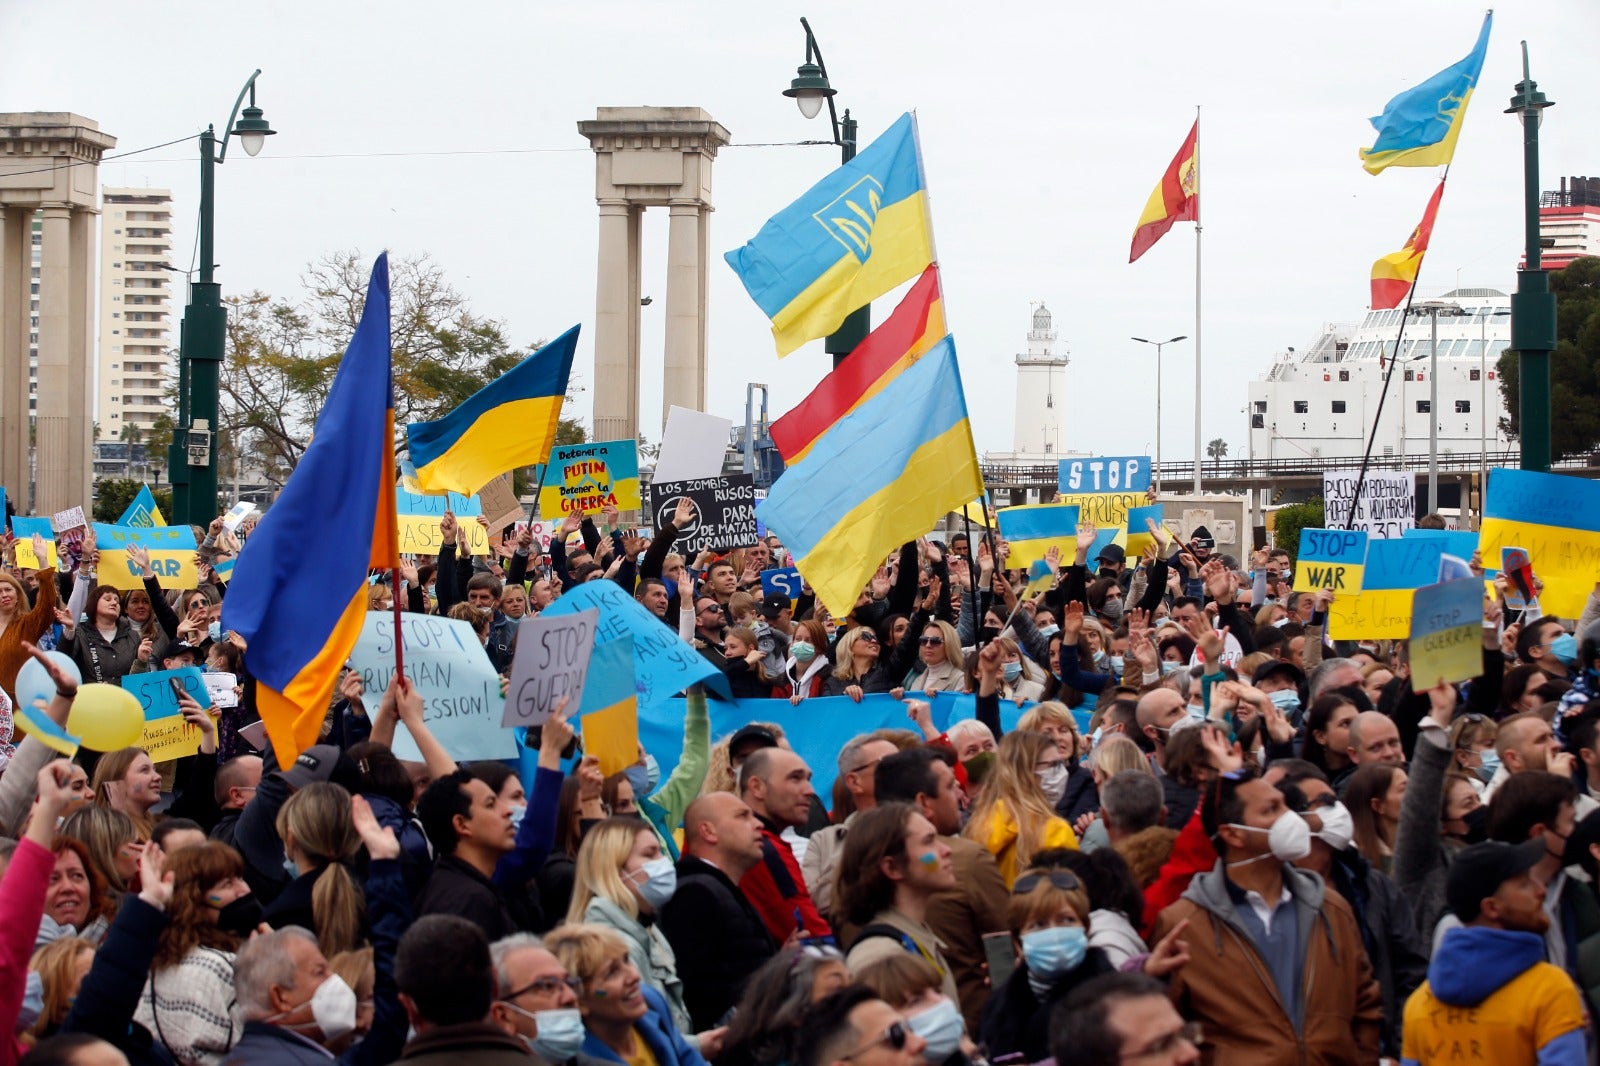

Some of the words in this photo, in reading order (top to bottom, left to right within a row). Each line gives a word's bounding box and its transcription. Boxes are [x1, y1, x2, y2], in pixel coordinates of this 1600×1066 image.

[558, 447, 597, 460] Detener
[600, 447, 608, 455] a
[563, 461, 606, 479] PUTIN
[1068, 459, 1139, 490] STOP
[658, 483, 682, 496] LOS
[686, 477, 729, 492] ZOMBIS
[715, 485, 753, 502] RUSOS
[409, 494, 471, 513] PUIN
[561, 493, 618, 512] GUERRA
[722, 504, 756, 523] PARA
[111, 530, 141, 541] NO
[150, 530, 180, 540] TO
[403, 523, 485, 547] ASENO
[700, 524, 715, 537] DE
[718, 520, 757, 534] MATAR
[1303, 531, 1358, 556] STOP
[126, 558, 181, 577] WAR
[1307, 567, 1345, 589] WAR
[1428, 609, 1462, 630] STOP
[594, 614, 630, 647] HE
[1423, 626, 1473, 652] GUERRA
[539, 621, 587, 670] STOP
[633, 628, 679, 663] AND
[363, 662, 451, 694] RUIAN
[140, 675, 199, 711] STOP
[143, 726, 180, 742] Russian
[1428, 1007, 1478, 1031] THE
